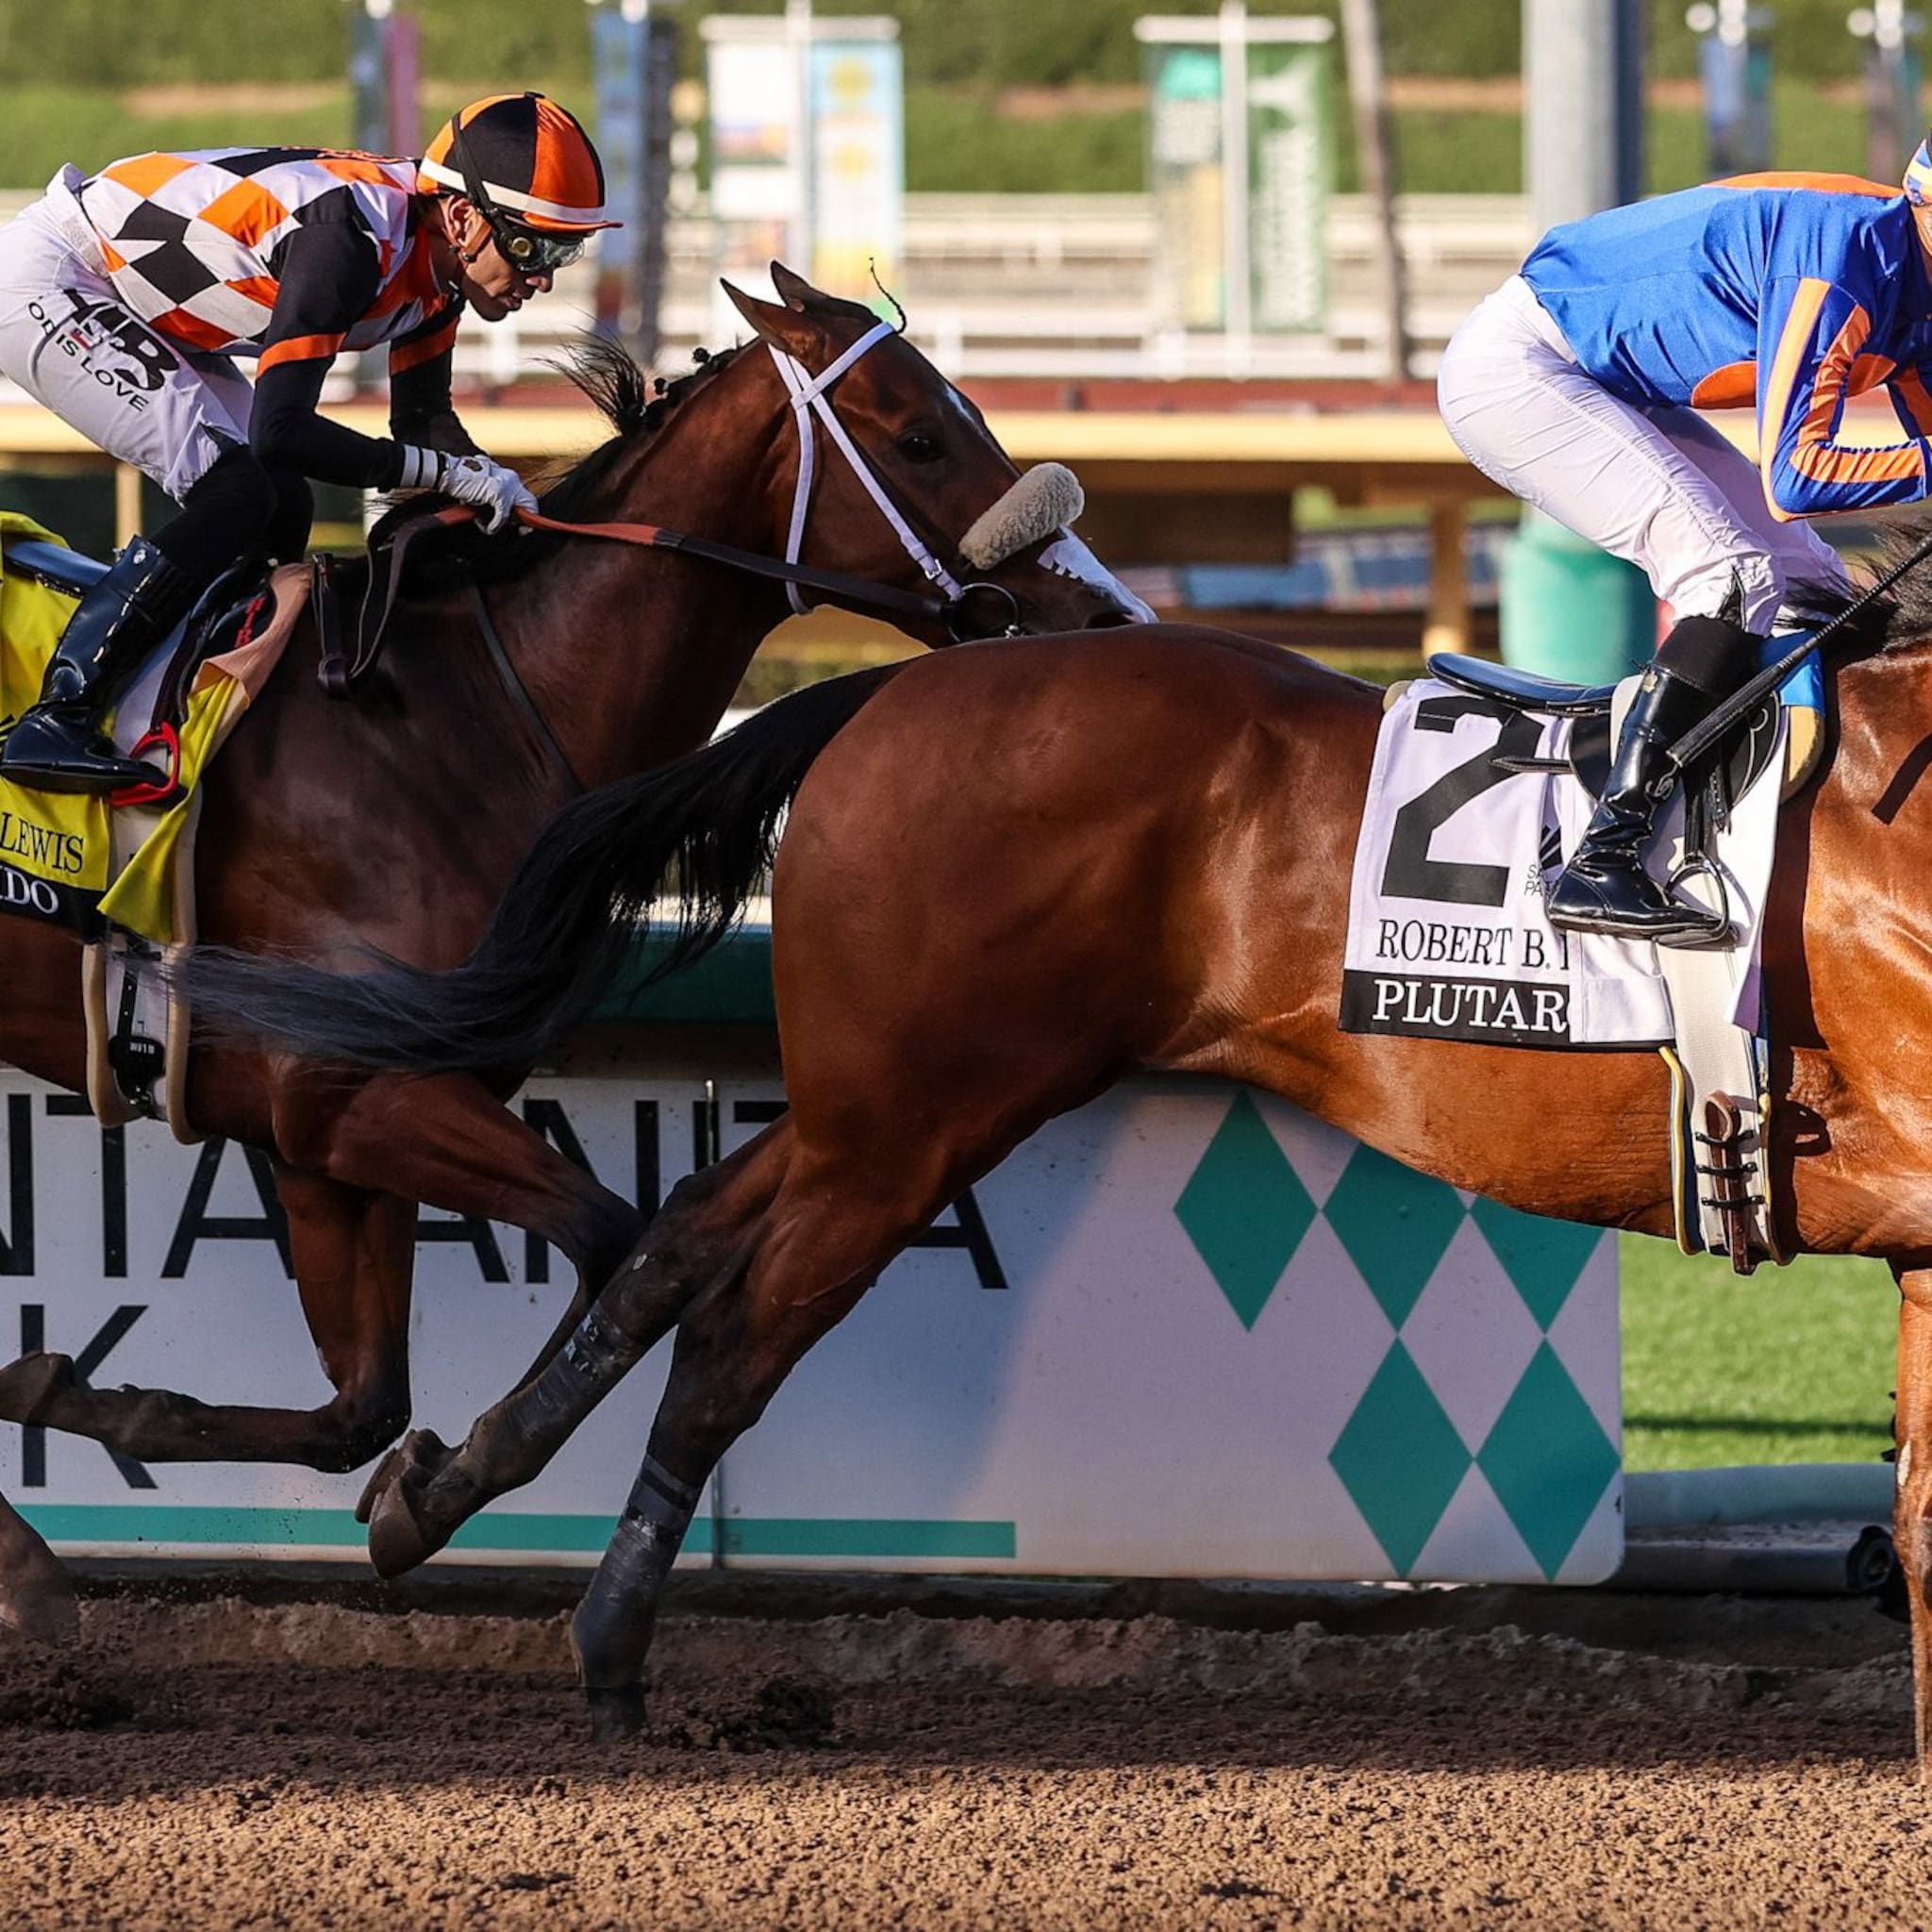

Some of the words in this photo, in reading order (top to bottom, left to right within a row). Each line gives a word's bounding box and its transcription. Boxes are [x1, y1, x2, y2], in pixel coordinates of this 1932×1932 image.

[56, 334, 79, 357] IS
[80, 357, 149, 412] LOVE
[1380, 694, 1546, 908] 2
[0, 811, 84, 874] LEWIS
[0, 866, 58, 914] DO
[1375, 919, 1513, 967] ROBERT
[1521, 928, 1552, 970] B.
[1372, 978, 1569, 1034] PLUTAR
[0, 1093, 297, 1280] TA
